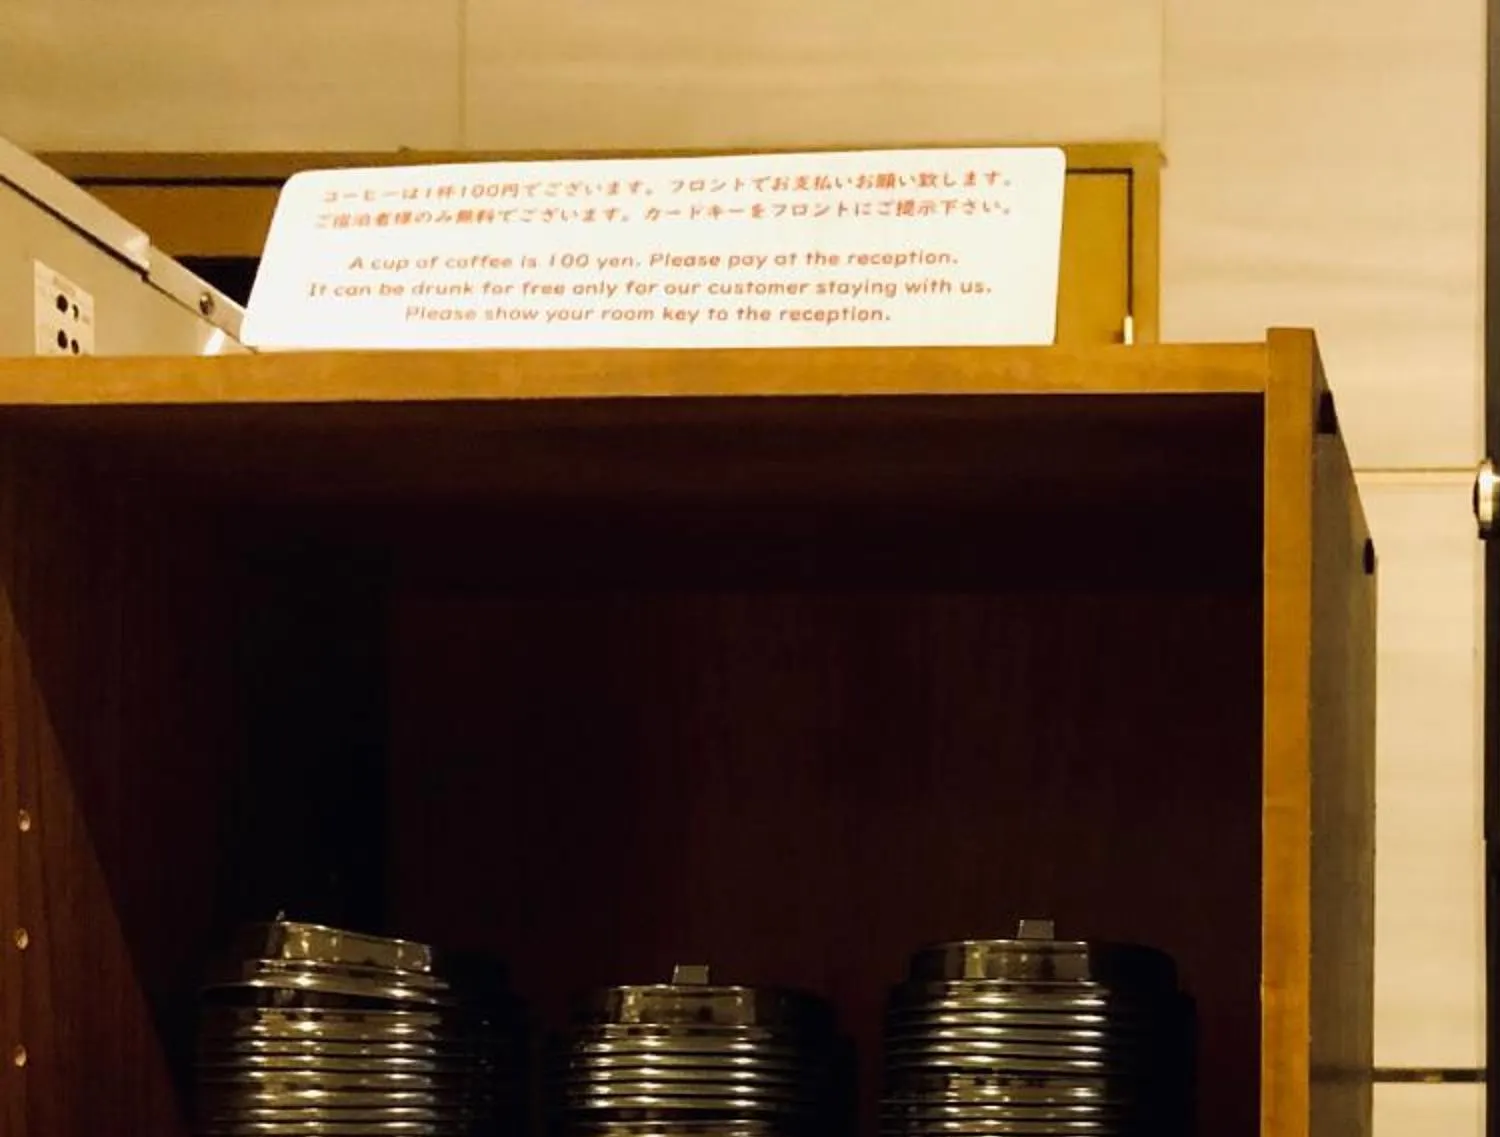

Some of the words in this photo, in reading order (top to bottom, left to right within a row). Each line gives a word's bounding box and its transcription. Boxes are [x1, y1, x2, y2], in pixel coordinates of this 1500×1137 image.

[348, 256, 366, 270] A
[370, 257, 410, 274] cup
[416, 256, 439, 270] of
[444, 254, 513, 269] coffee
[521, 256, 537, 269] is
[549, 253, 590, 269] 100
[595, 256, 640, 270] yen.
[649, 252, 721, 269] Please
[728, 254, 768, 270] pay
[773, 252, 798, 268] at
[804, 249, 841, 268] the
[846, 248, 958, 269] reception.
[308, 282, 329, 297] It
[333, 284, 371, 298] can
[379, 282, 405, 297] be
[411, 281, 473, 297] drunk
[480, 280, 515, 295] for
[522, 281, 566, 296] free
[572, 280, 619, 299] only
[624, 280, 659, 296] for
[663, 282, 701, 296] our
[707, 280, 810, 297] customer
[815, 278, 898, 299] staying
[904, 278, 952, 296] with
[959, 281, 992, 295] us.
[405, 305, 478, 322] Please
[485, 306, 539, 321] show
[546, 308, 595, 324] your
[601, 308, 655, 322] room
[662, 307, 701, 325] key
[707, 308, 728, 321] to
[736, 305, 772, 322] the
[780, 306, 890, 326] reception.
